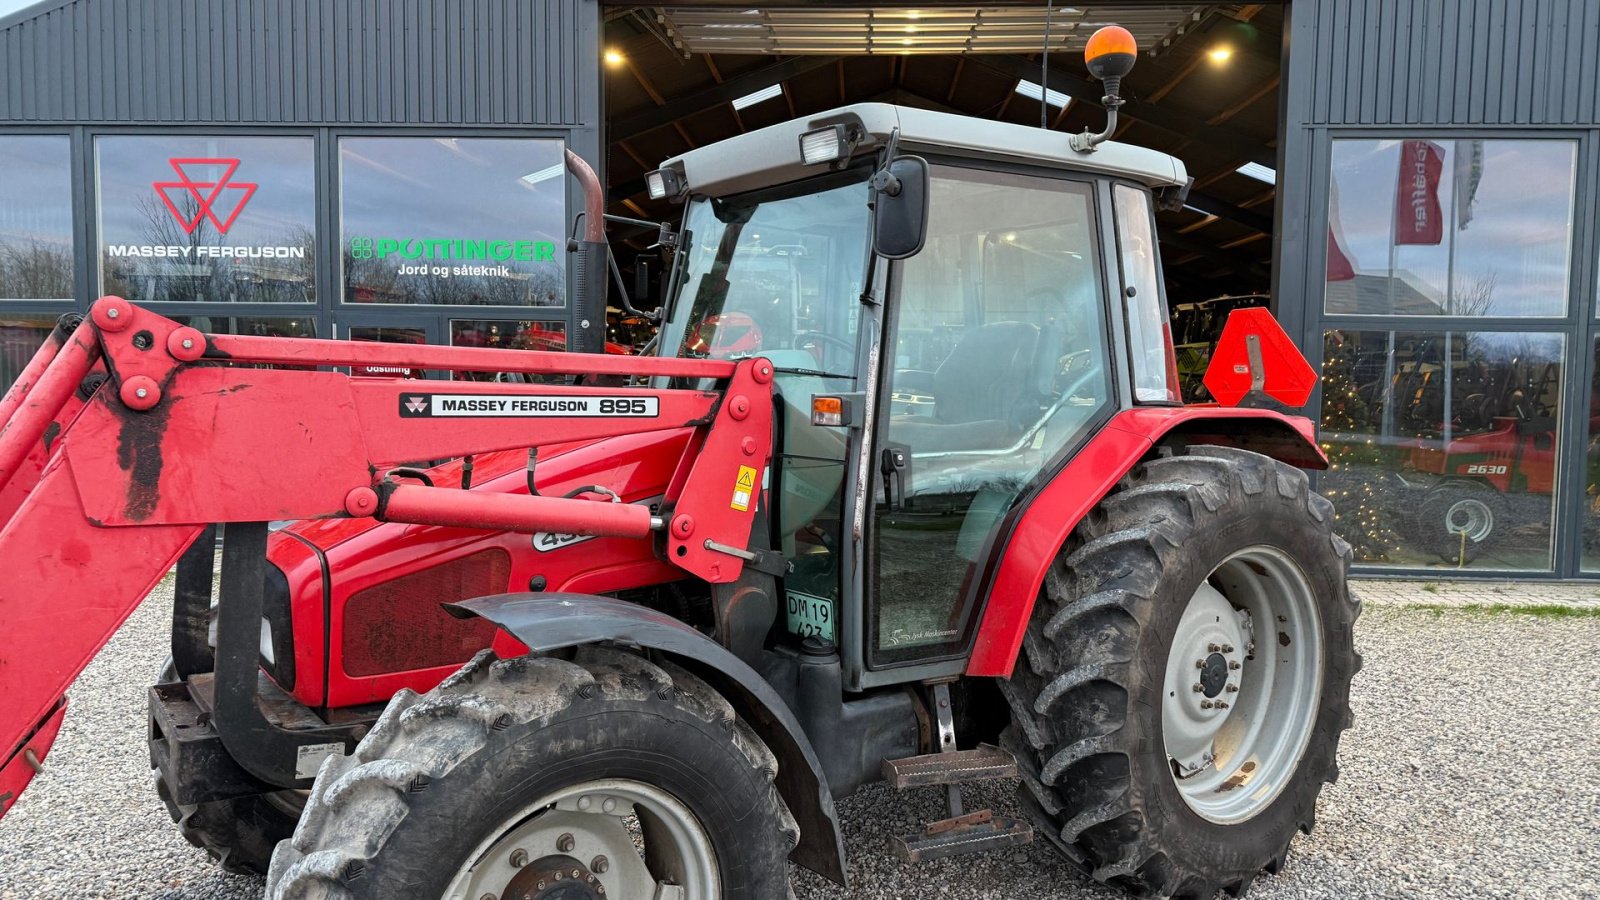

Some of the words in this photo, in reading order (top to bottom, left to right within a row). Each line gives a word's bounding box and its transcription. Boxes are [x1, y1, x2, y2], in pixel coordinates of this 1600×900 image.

[109, 245, 194, 257] MASSEY
[197, 246, 305, 258] FERGUSON
[398, 264, 428, 276] Jord
[432, 267, 449, 278] og
[453, 264, 509, 277] såteknik
[442, 399, 507, 412] MASSEY
[511, 400, 588, 412] FERGUSON
[599, 399, 647, 414] 895
[1467, 464, 1507, 475] 2630
[788, 596, 808, 618] DM
[812, 602, 829, 623] 19
